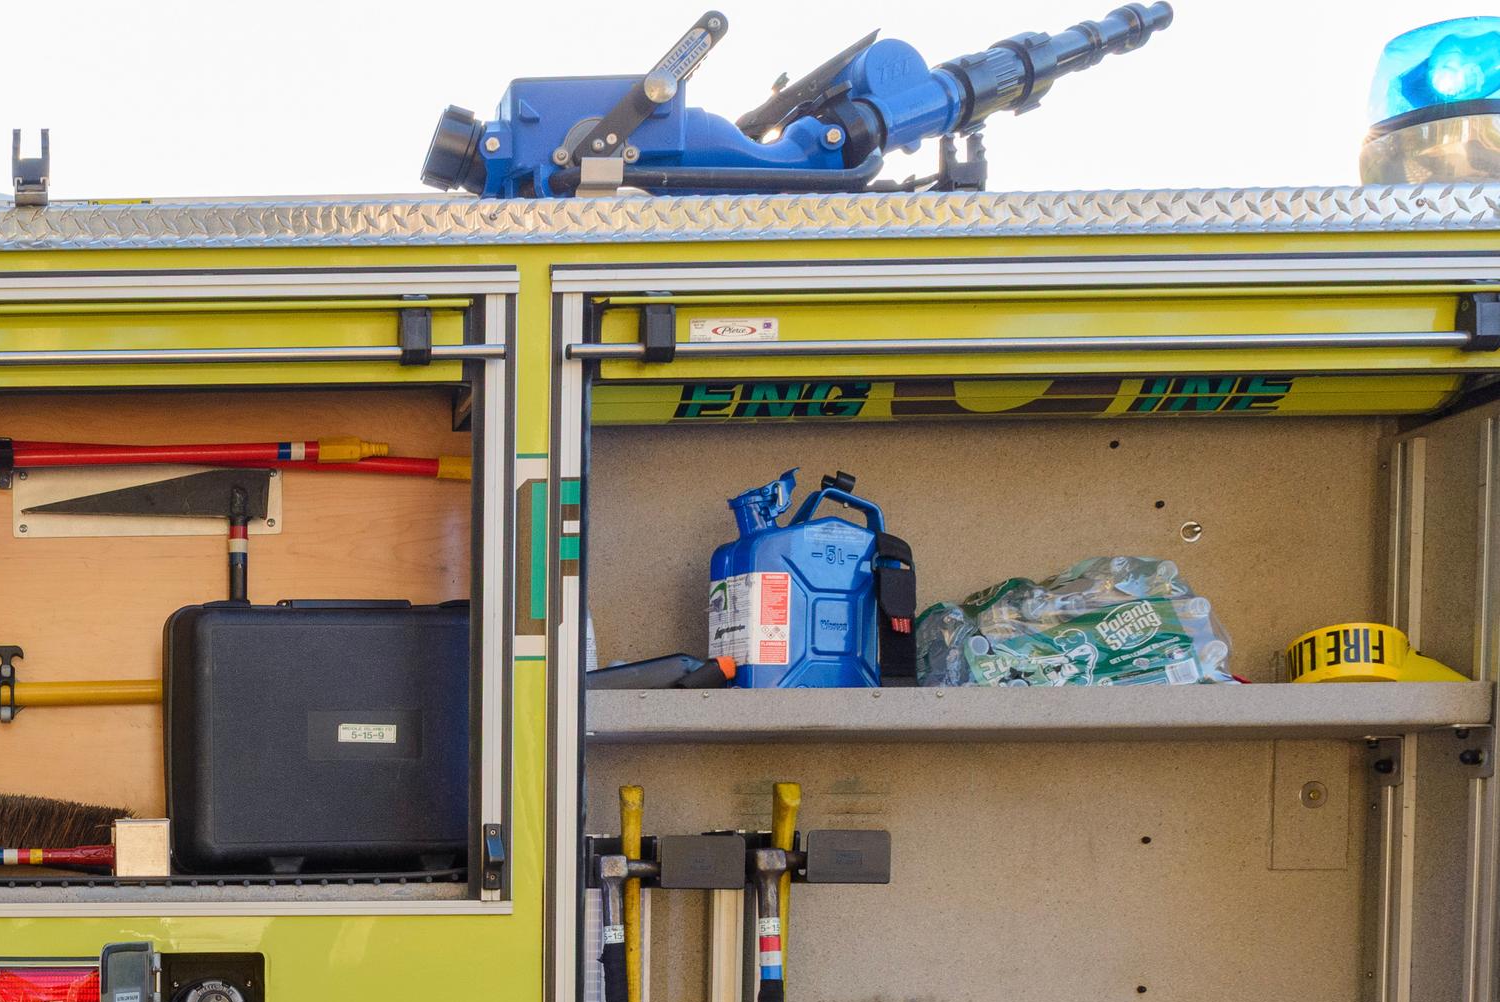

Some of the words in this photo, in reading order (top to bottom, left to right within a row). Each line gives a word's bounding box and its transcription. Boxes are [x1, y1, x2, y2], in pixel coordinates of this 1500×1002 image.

[1095, 600, 1155, 640] Poland
[1105, 612, 1162, 651] Spring
[1288, 636, 1316, 682] LIN
[1326, 628, 1385, 666] FIRE
[351, 731, 385, 740] 5-15-9
